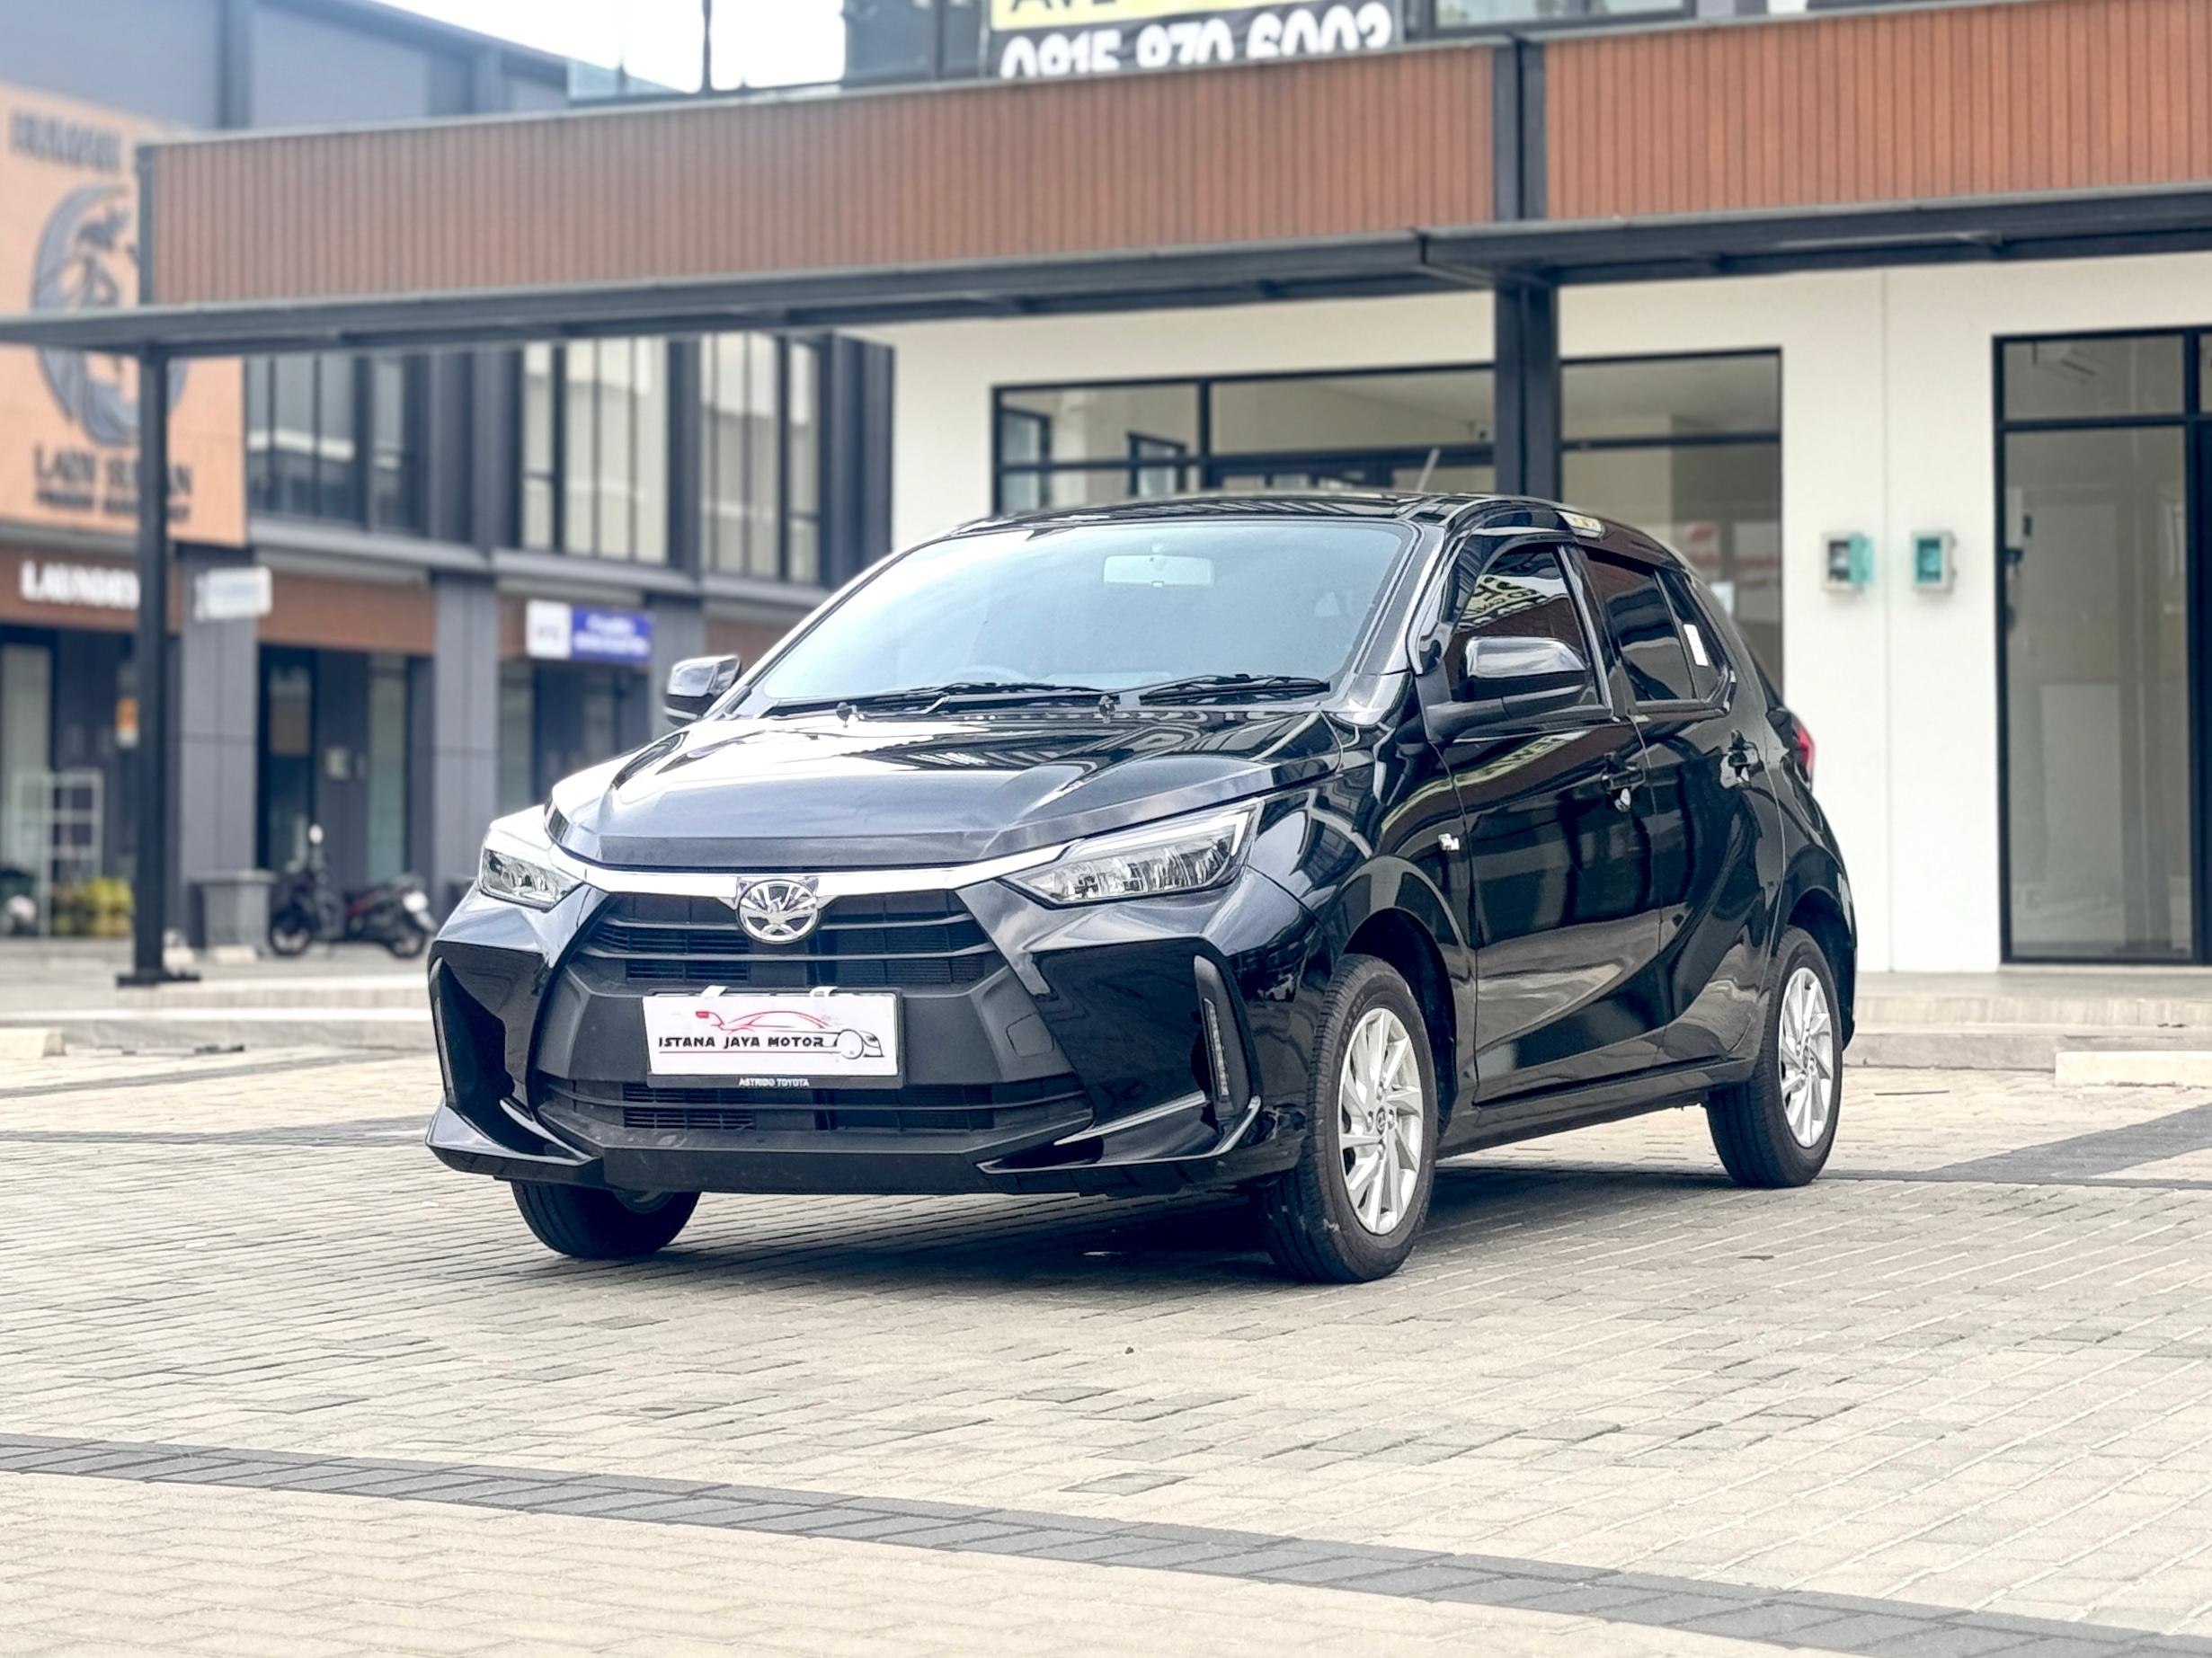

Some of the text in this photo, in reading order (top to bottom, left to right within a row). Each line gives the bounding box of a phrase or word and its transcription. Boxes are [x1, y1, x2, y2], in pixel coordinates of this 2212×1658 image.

[659, 1036, 824, 1049] ISTANA JAYA MOTOR
[776, 1077, 810, 1087] TOYOTA
